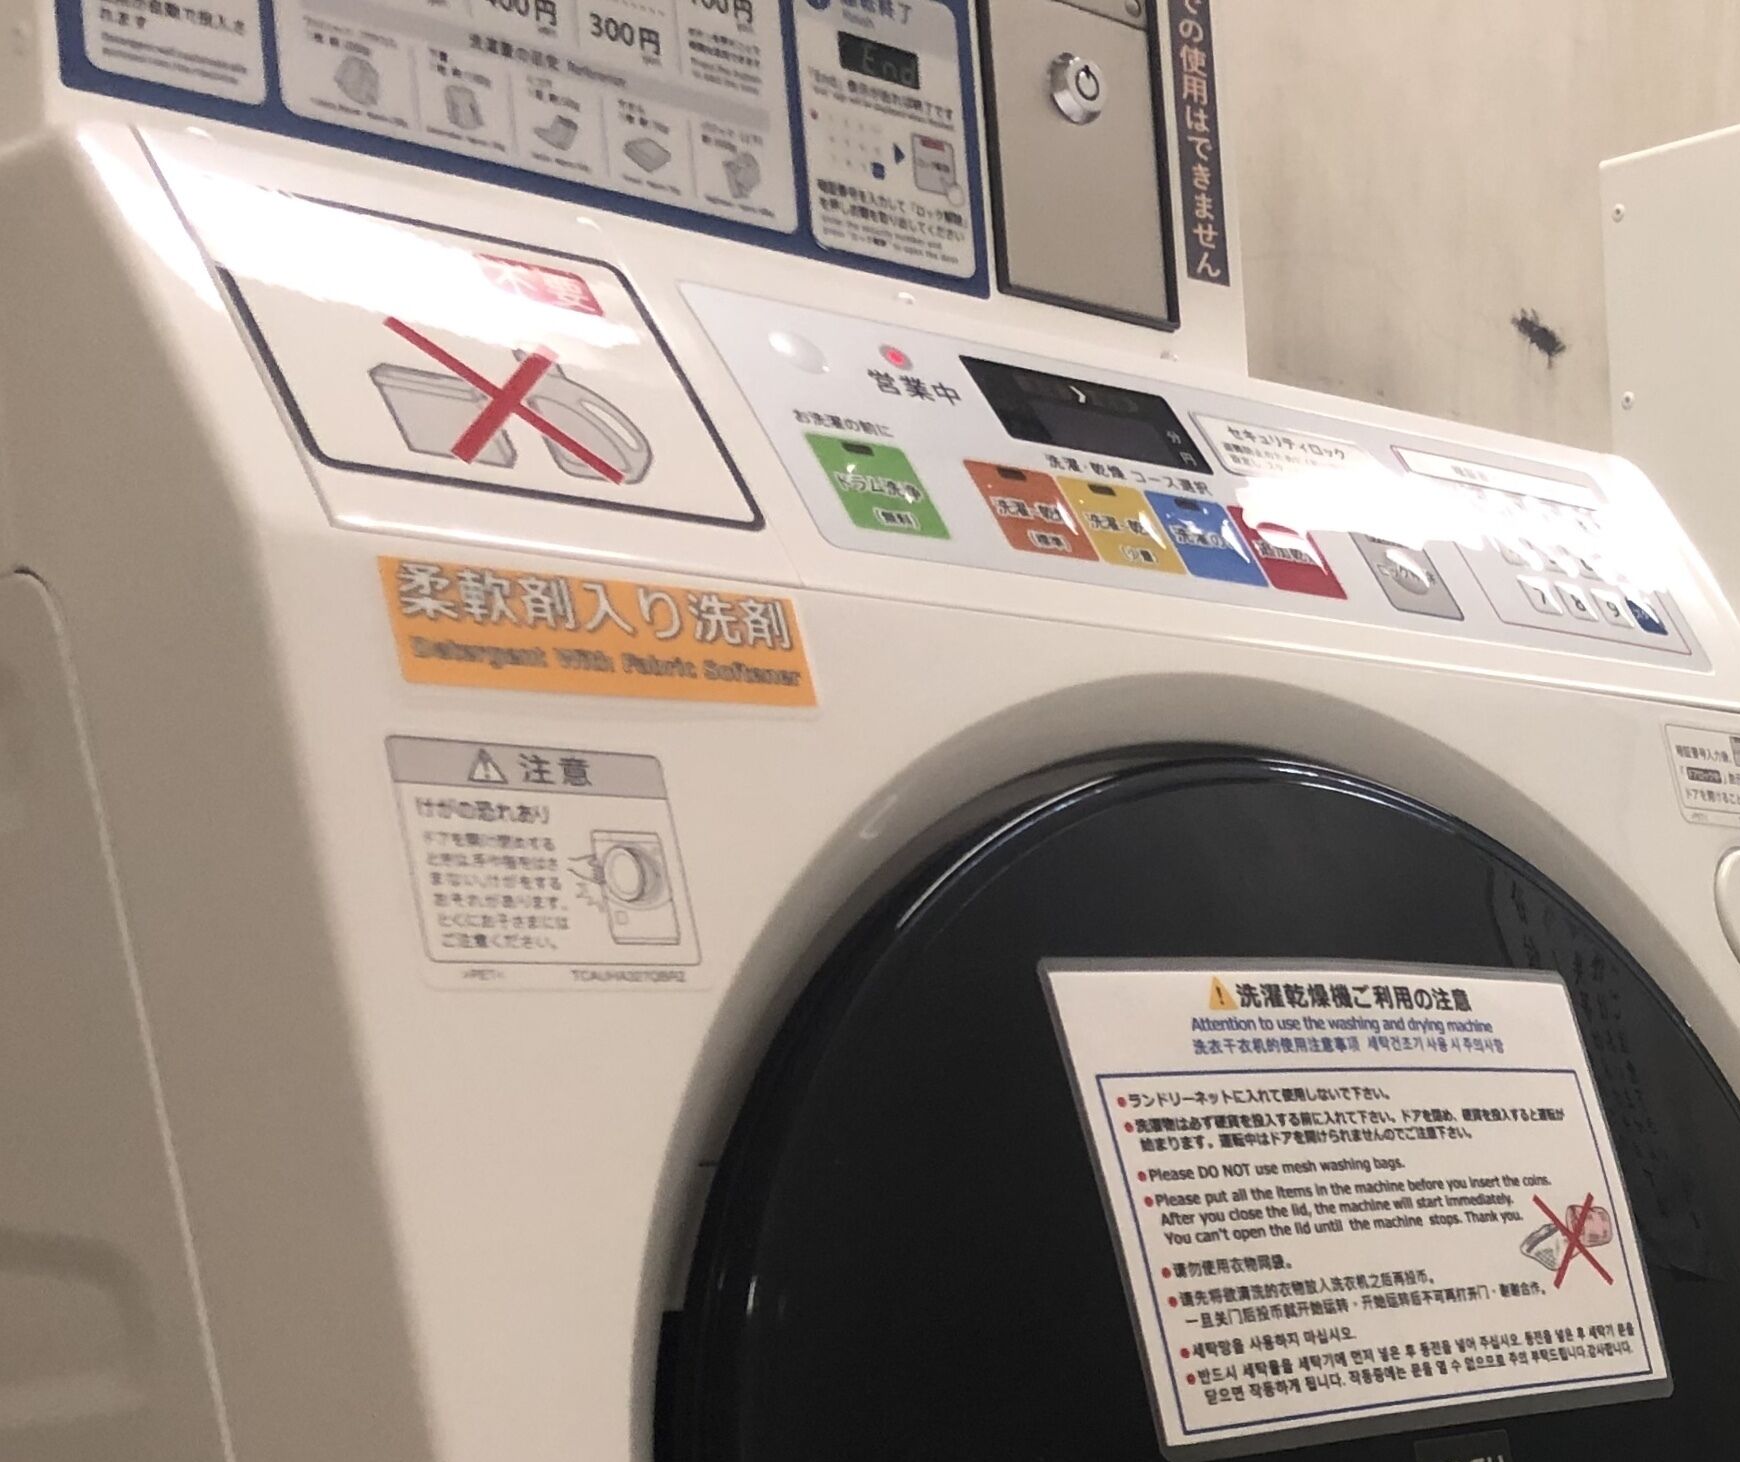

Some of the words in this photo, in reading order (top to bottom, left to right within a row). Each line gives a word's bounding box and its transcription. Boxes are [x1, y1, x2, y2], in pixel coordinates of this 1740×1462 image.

[590, 11, 661, 56] 300円
[867, 367, 962, 407] 営業中
[1226, 425, 1347, 461] セキュリティロック
[399, 562, 794, 651] 柔軟剤入り洗剤
[518, 753, 594, 788] 注意
[1236, 983, 1473, 1012] 洗濯乾燥機ご利用の注意
[1192, 1016, 1256, 1032] Attention
[1258, 1017, 1274, 1032] to
[1276, 1018, 1300, 1032] use
[1303, 1016, 1326, 1031] the
[1328, 1016, 1381, 1035] washing
[1383, 1017, 1406, 1032] and
[1408, 1017, 1445, 1035] drying
[1447, 1019, 1494, 1034] machine
[1149, 1166, 1195, 1182] Please
[1198, 1165, 1219, 1179] DO
[1223, 1163, 1251, 1178] NOT
[1255, 1162, 1278, 1176] use
[1282, 1160, 1317, 1174] mesh
[1321, 1157, 1372, 1174] washing
[1373, 1156, 1406, 1172] bags.
[1154, 1193, 1200, 1208] Please
[1205, 1190, 1228, 1206] put
[1231, 1188, 1248, 1202] all
[1251, 1186, 1273, 1201] the
[1315, 1183, 1328, 1196] in
[1331, 1182, 1352, 1196] the
[1355, 1179, 1405, 1196] machine
[1407, 1177, 1445, 1193] before
[1447, 1178, 1467, 1194] you
[1502, 1173, 1520, 1188] the
[1522, 1173, 1553, 1188] coins.
[1161, 1212, 1196, 1227] After
[1199, 1211, 1226, 1227] you
[1229, 1206, 1264, 1222] close
[1266, 1205, 1289, 1219] the
[1292, 1203, 1313, 1219] lid,
[1315, 1201, 1337, 1215] the
[1340, 1197, 1391, 1214] machine
[1393, 1196, 1414, 1210] will
[1416, 1195, 1443, 1209] start
[1164, 1230, 1192, 1246] You
[1195, 1227, 1230, 1244] can't
[1233, 1226, 1267, 1243] open
[1269, 1223, 1292, 1237] the
[1294, 1221, 1311, 1236] lid
[1315, 1219, 1344, 1234] until
[1349, 1218, 1372, 1232] the
[1373, 1214, 1424, 1230] machine
[1428, 1212, 1463, 1228] stops.
[1464, 1209, 1499, 1223] Thank
[1500, 1211, 1524, 1225] you.
